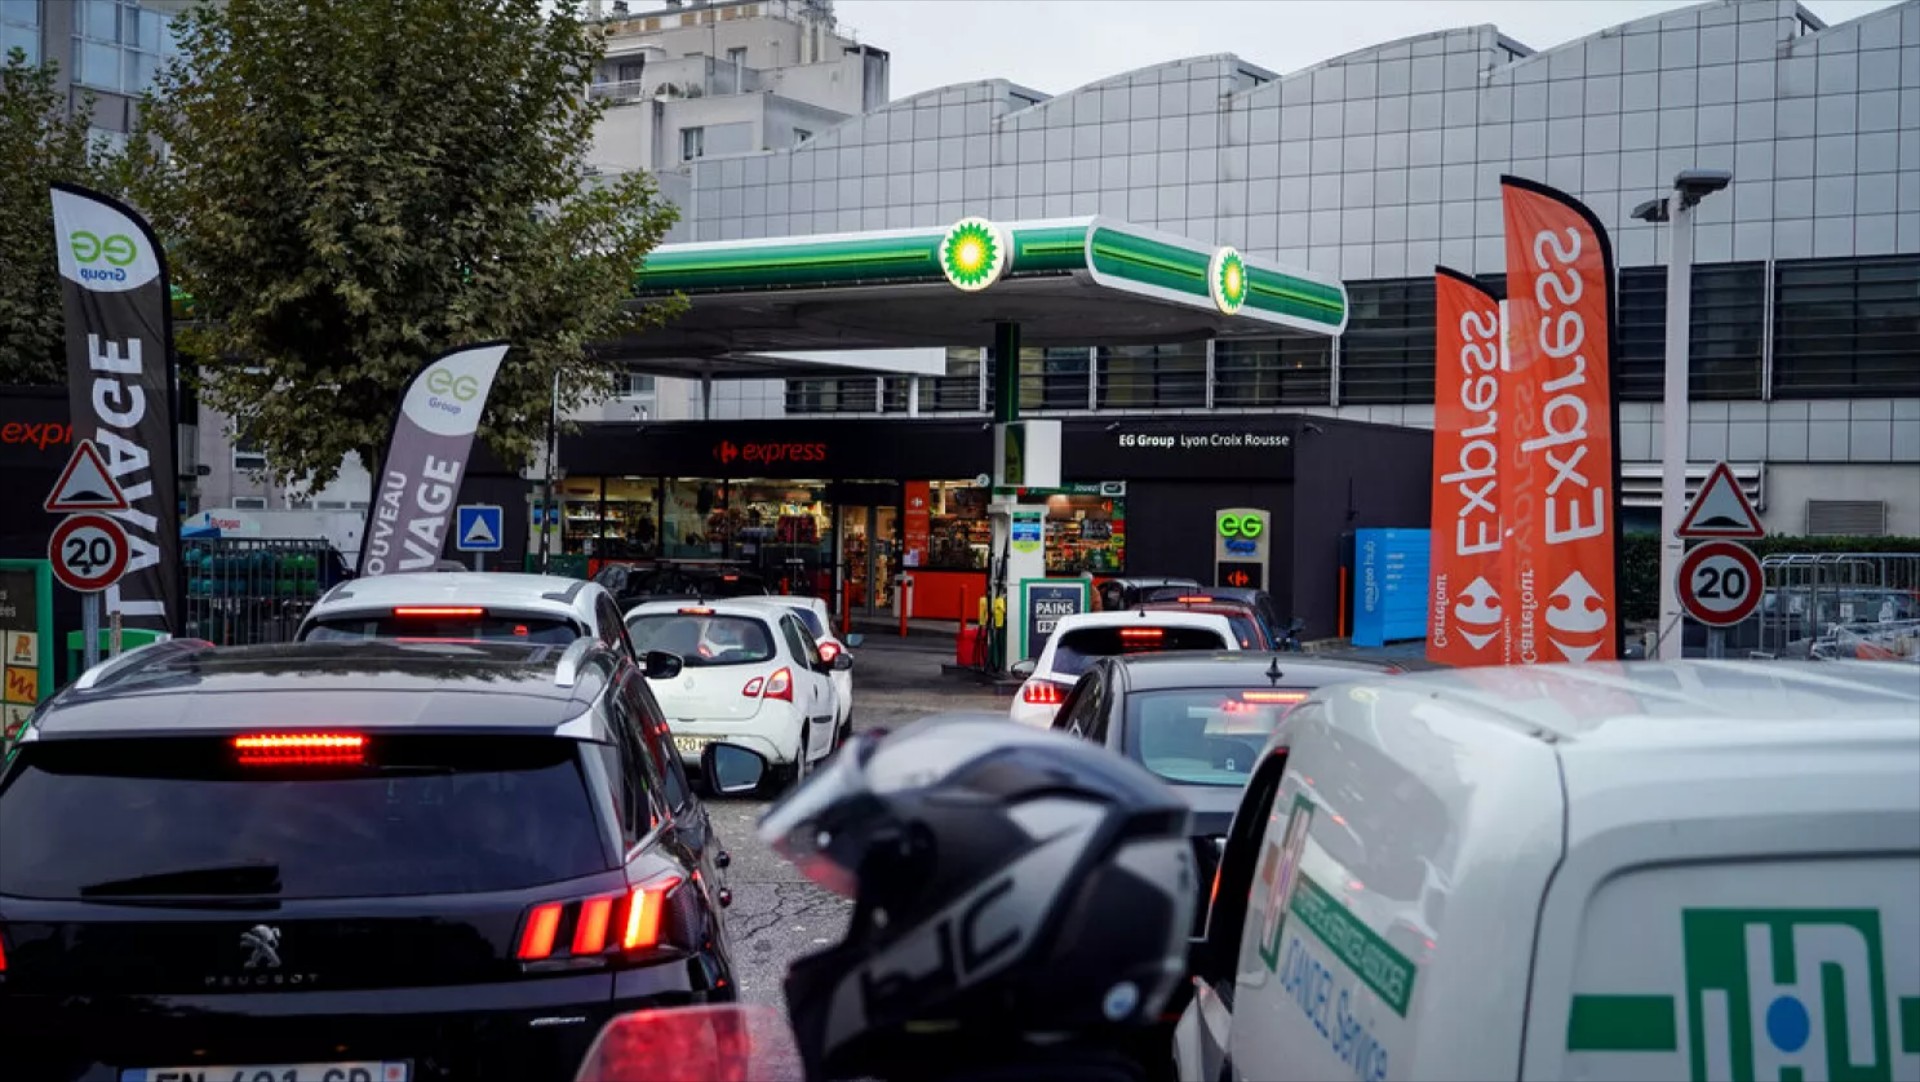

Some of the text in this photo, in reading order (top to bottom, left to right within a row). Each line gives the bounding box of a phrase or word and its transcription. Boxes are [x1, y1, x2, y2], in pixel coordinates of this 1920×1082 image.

[428, 396, 461, 415] Group
[1119, 434, 1290, 448] EG Group Lyon Croix Rousse
[743, 443, 827, 465] express
[66, 537, 112, 568] 20
[1697, 567, 1746, 599] 20
[1036, 602, 1074, 614] PAINS
[204, 973, 320, 986] PEUGEOT
